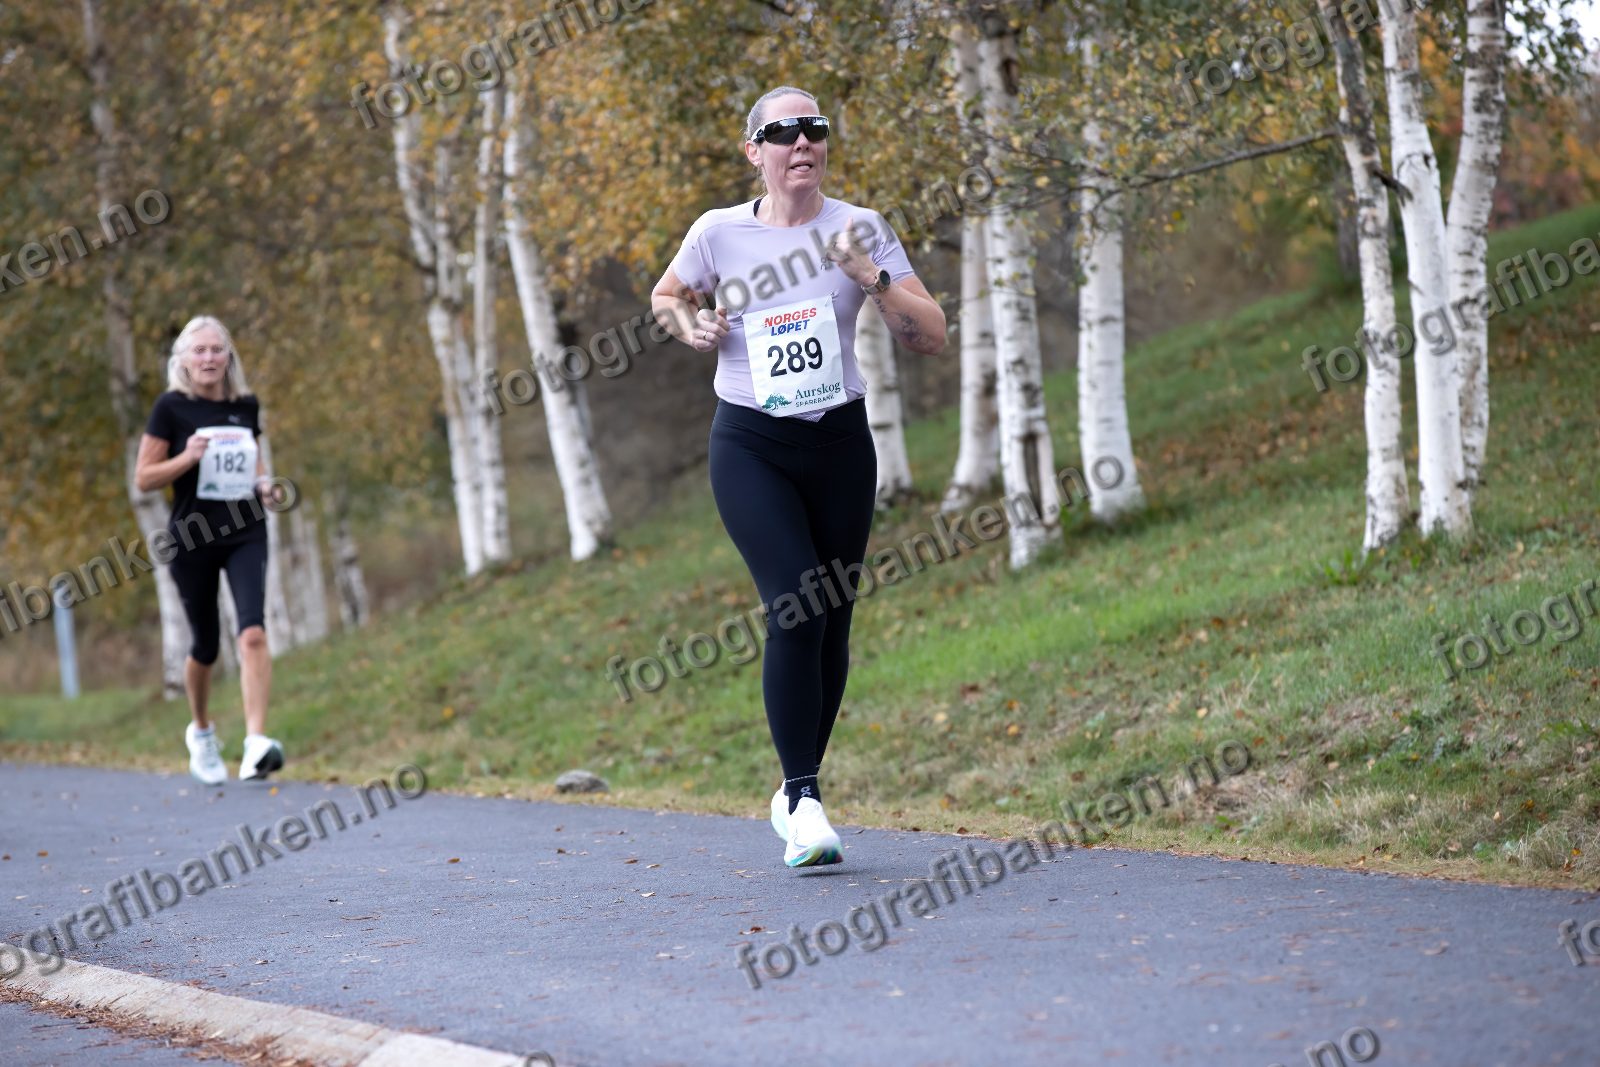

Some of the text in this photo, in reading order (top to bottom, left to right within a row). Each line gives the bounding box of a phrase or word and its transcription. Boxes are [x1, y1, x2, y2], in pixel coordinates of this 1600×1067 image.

[764, 307, 818, 328] NORGES
[770, 319, 811, 337] LØPET
[767, 336, 823, 378] 289
[794, 381, 842, 400] Aurskog
[214, 451, 246, 473] 182
